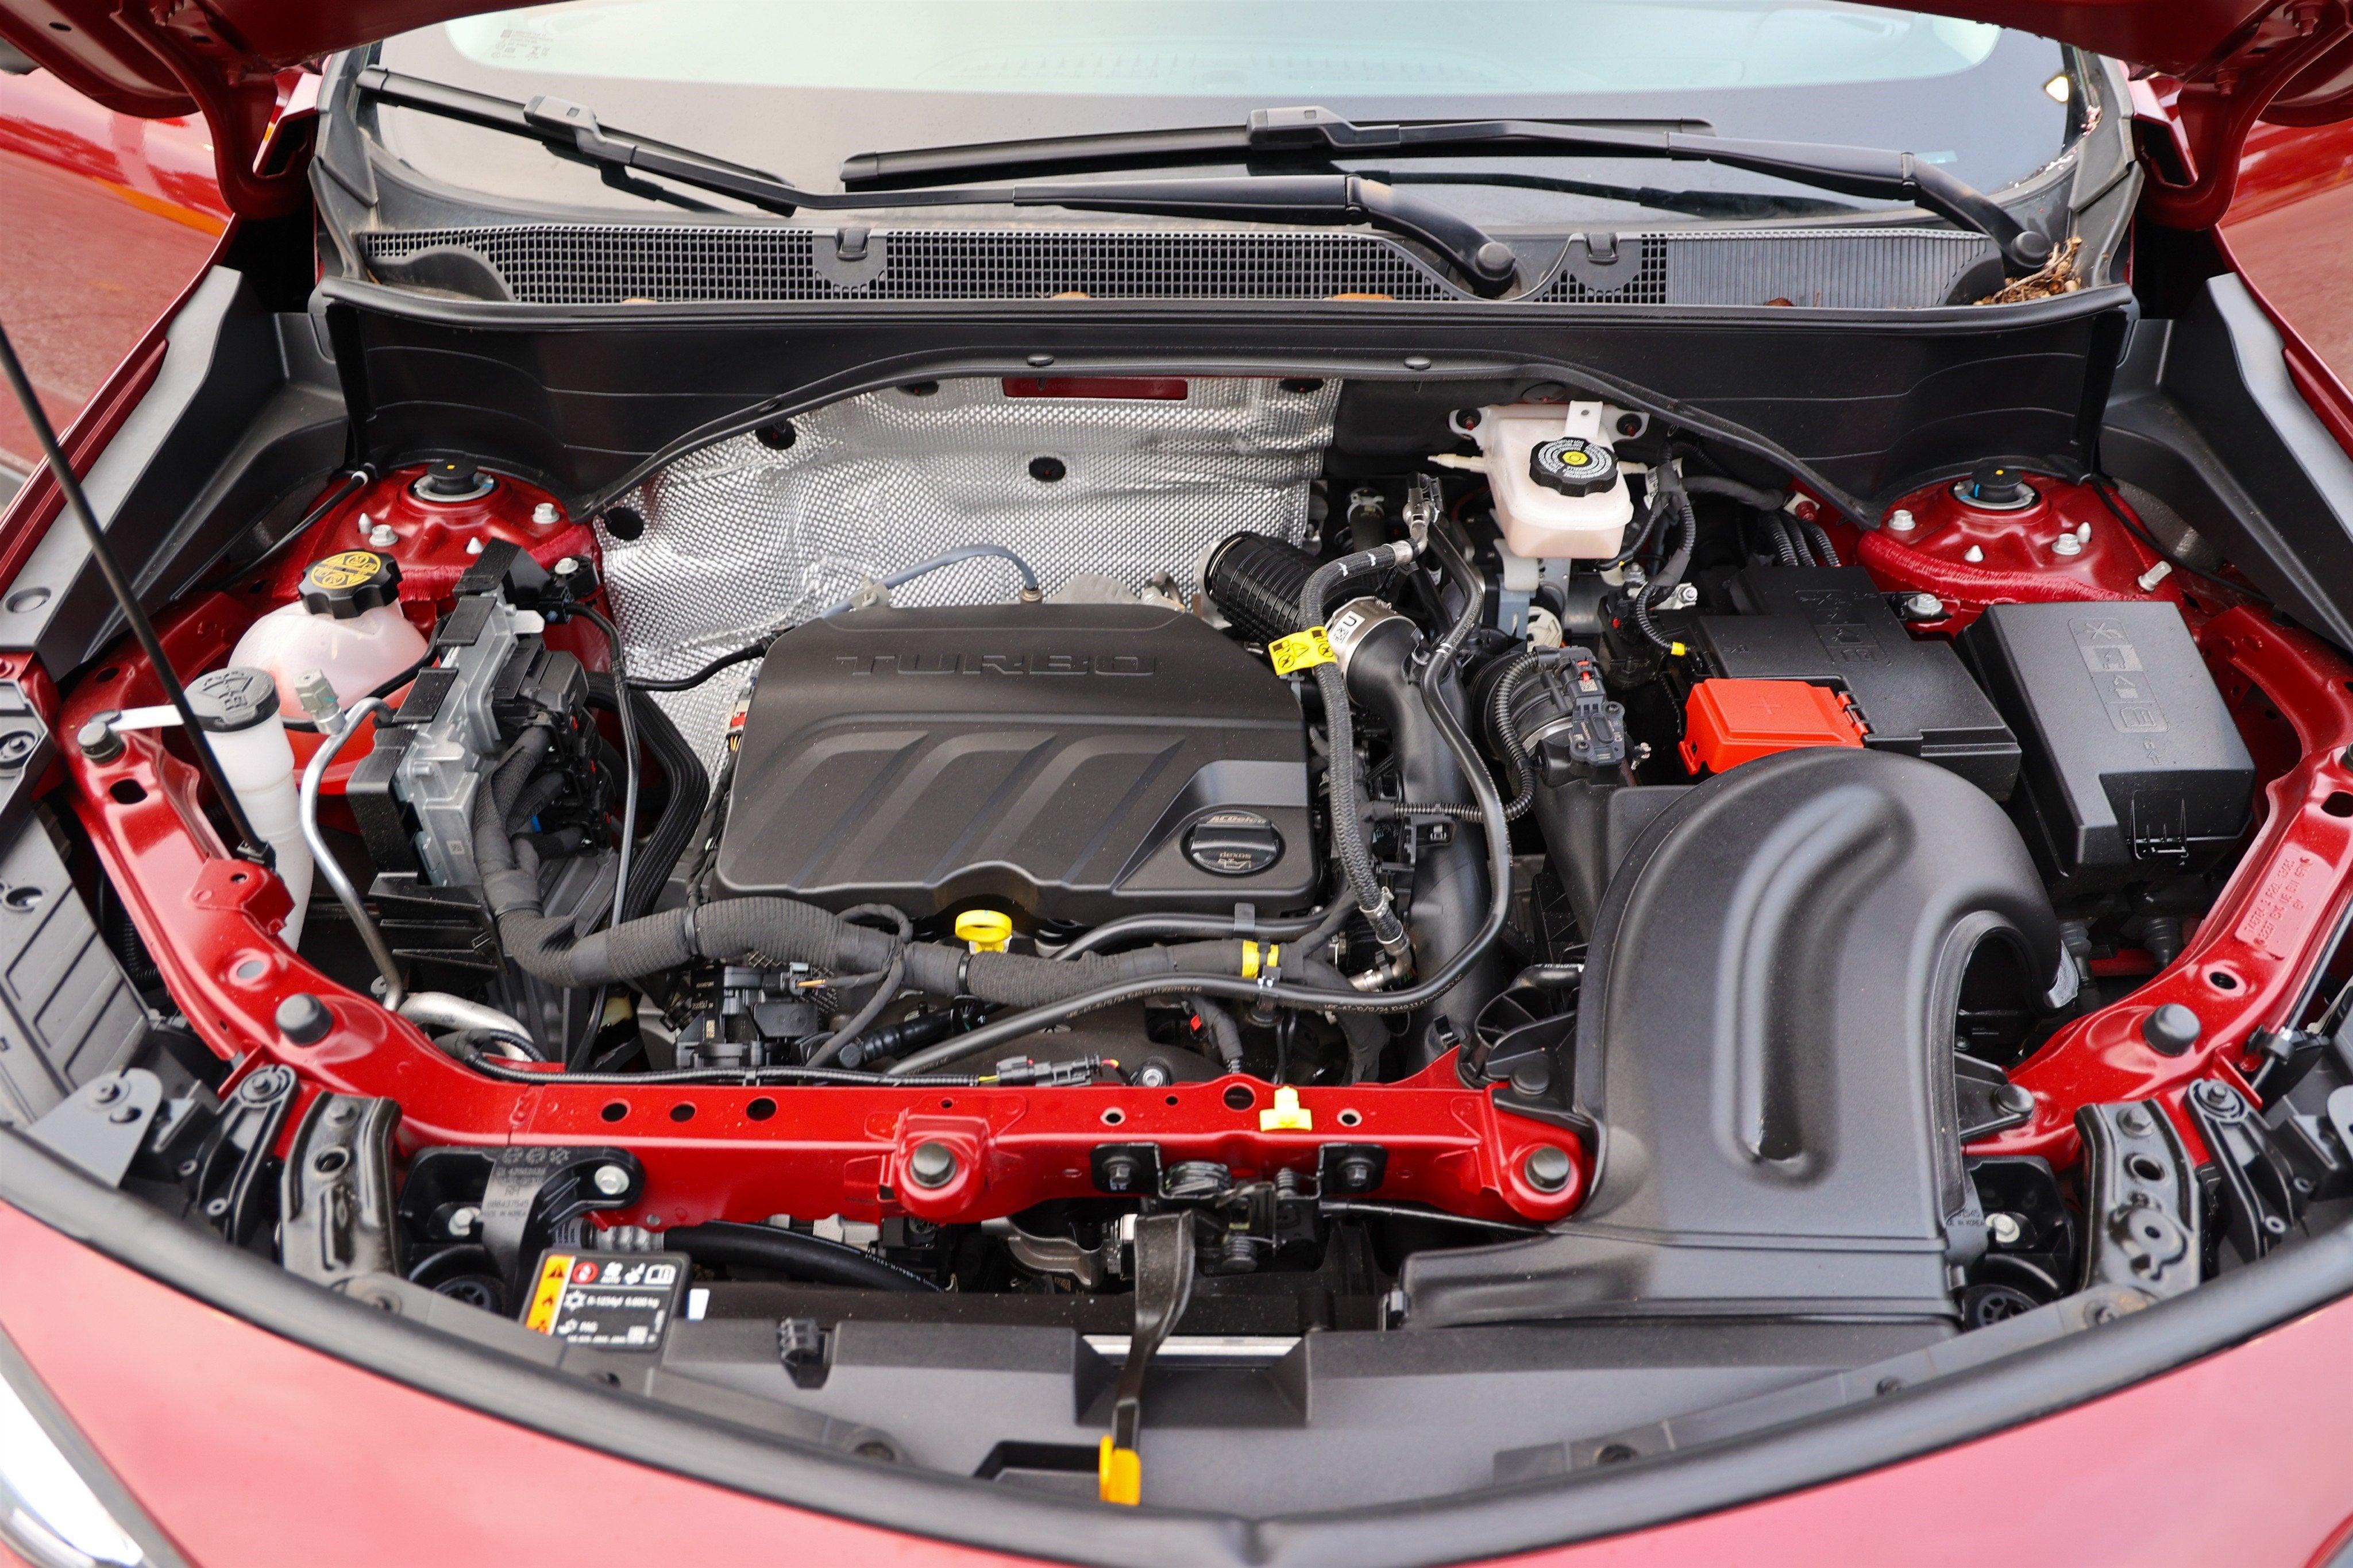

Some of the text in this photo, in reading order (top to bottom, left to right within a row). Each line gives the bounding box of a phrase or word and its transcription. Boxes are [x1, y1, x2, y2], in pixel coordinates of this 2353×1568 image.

[1343, 615, 1357, 627] U
[836, 654, 1156, 677] TURBO
[1207, 816, 1267, 825] ACDelco
